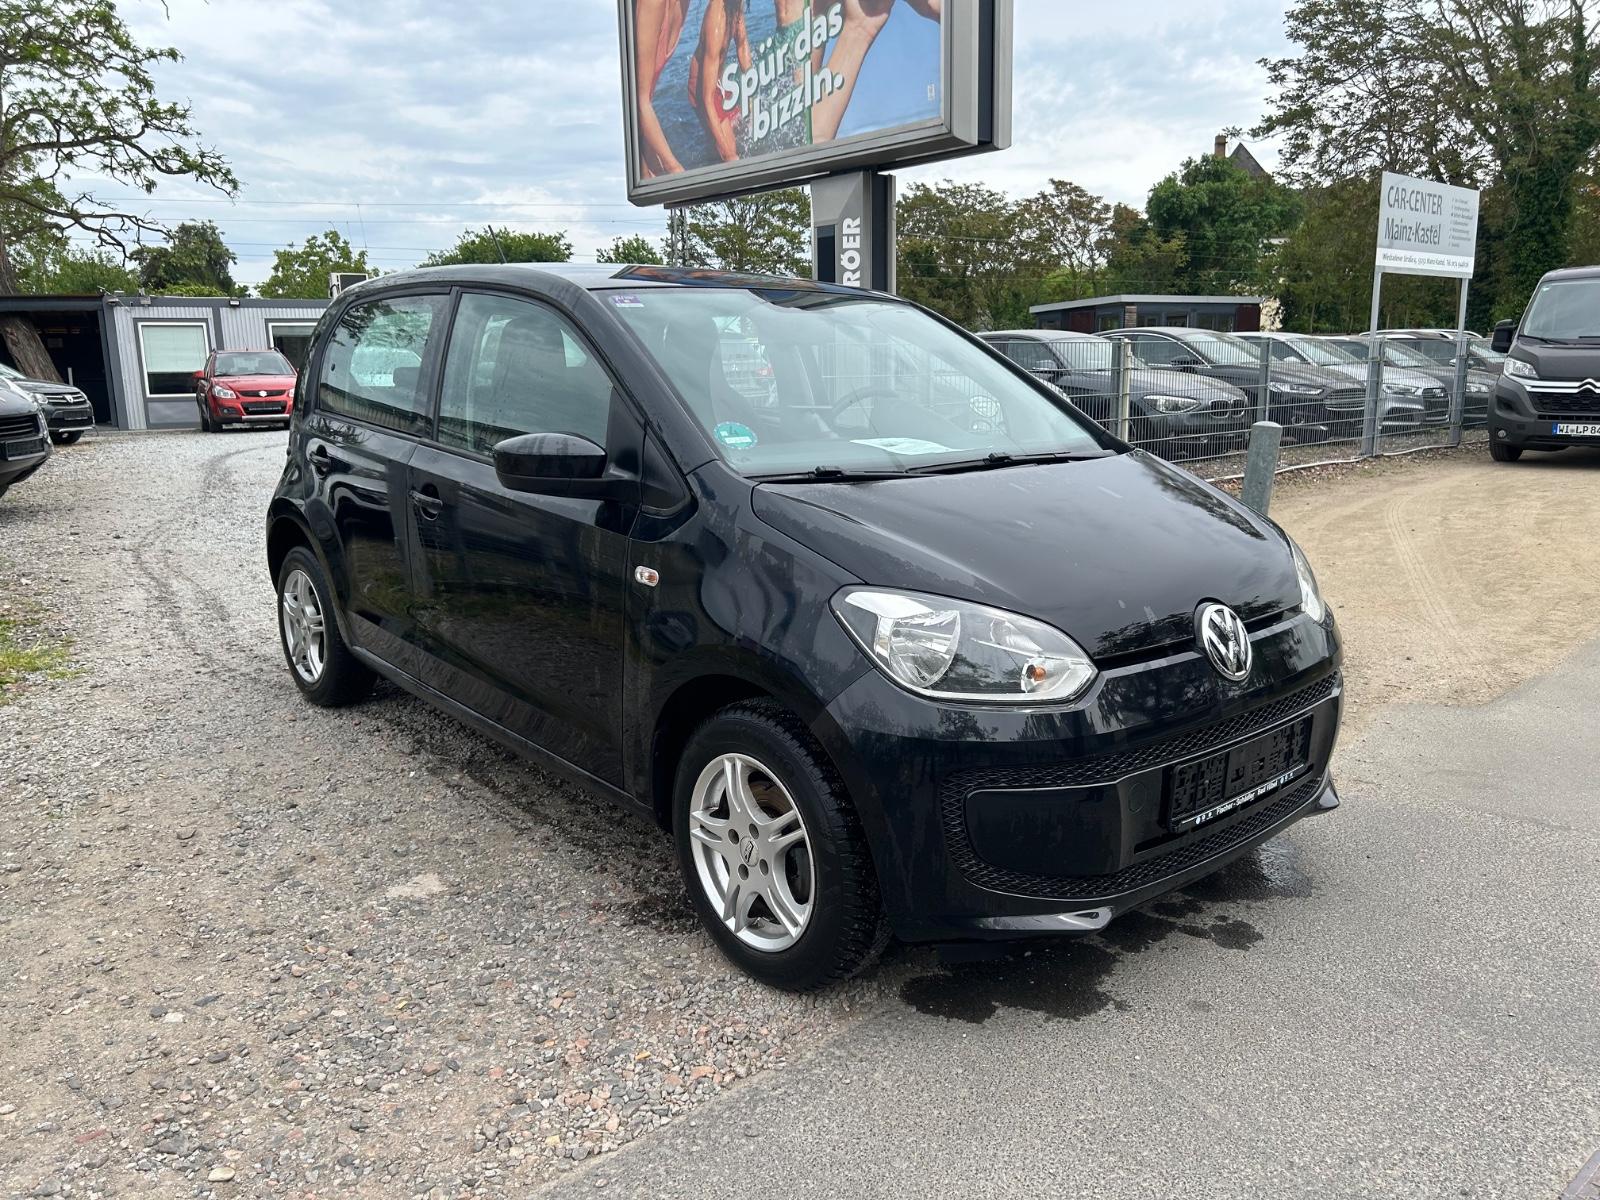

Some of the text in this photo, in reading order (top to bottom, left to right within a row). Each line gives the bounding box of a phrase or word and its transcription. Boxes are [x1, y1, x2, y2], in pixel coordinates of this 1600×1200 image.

[721, 3, 843, 118] Spür das
[753, 60, 843, 142] bizzln.
[1387, 185, 1443, 215] CAR-CENTER
[1384, 217, 1442, 245] Mainz-Kastel
[1576, 425, 1589, 434] LP
